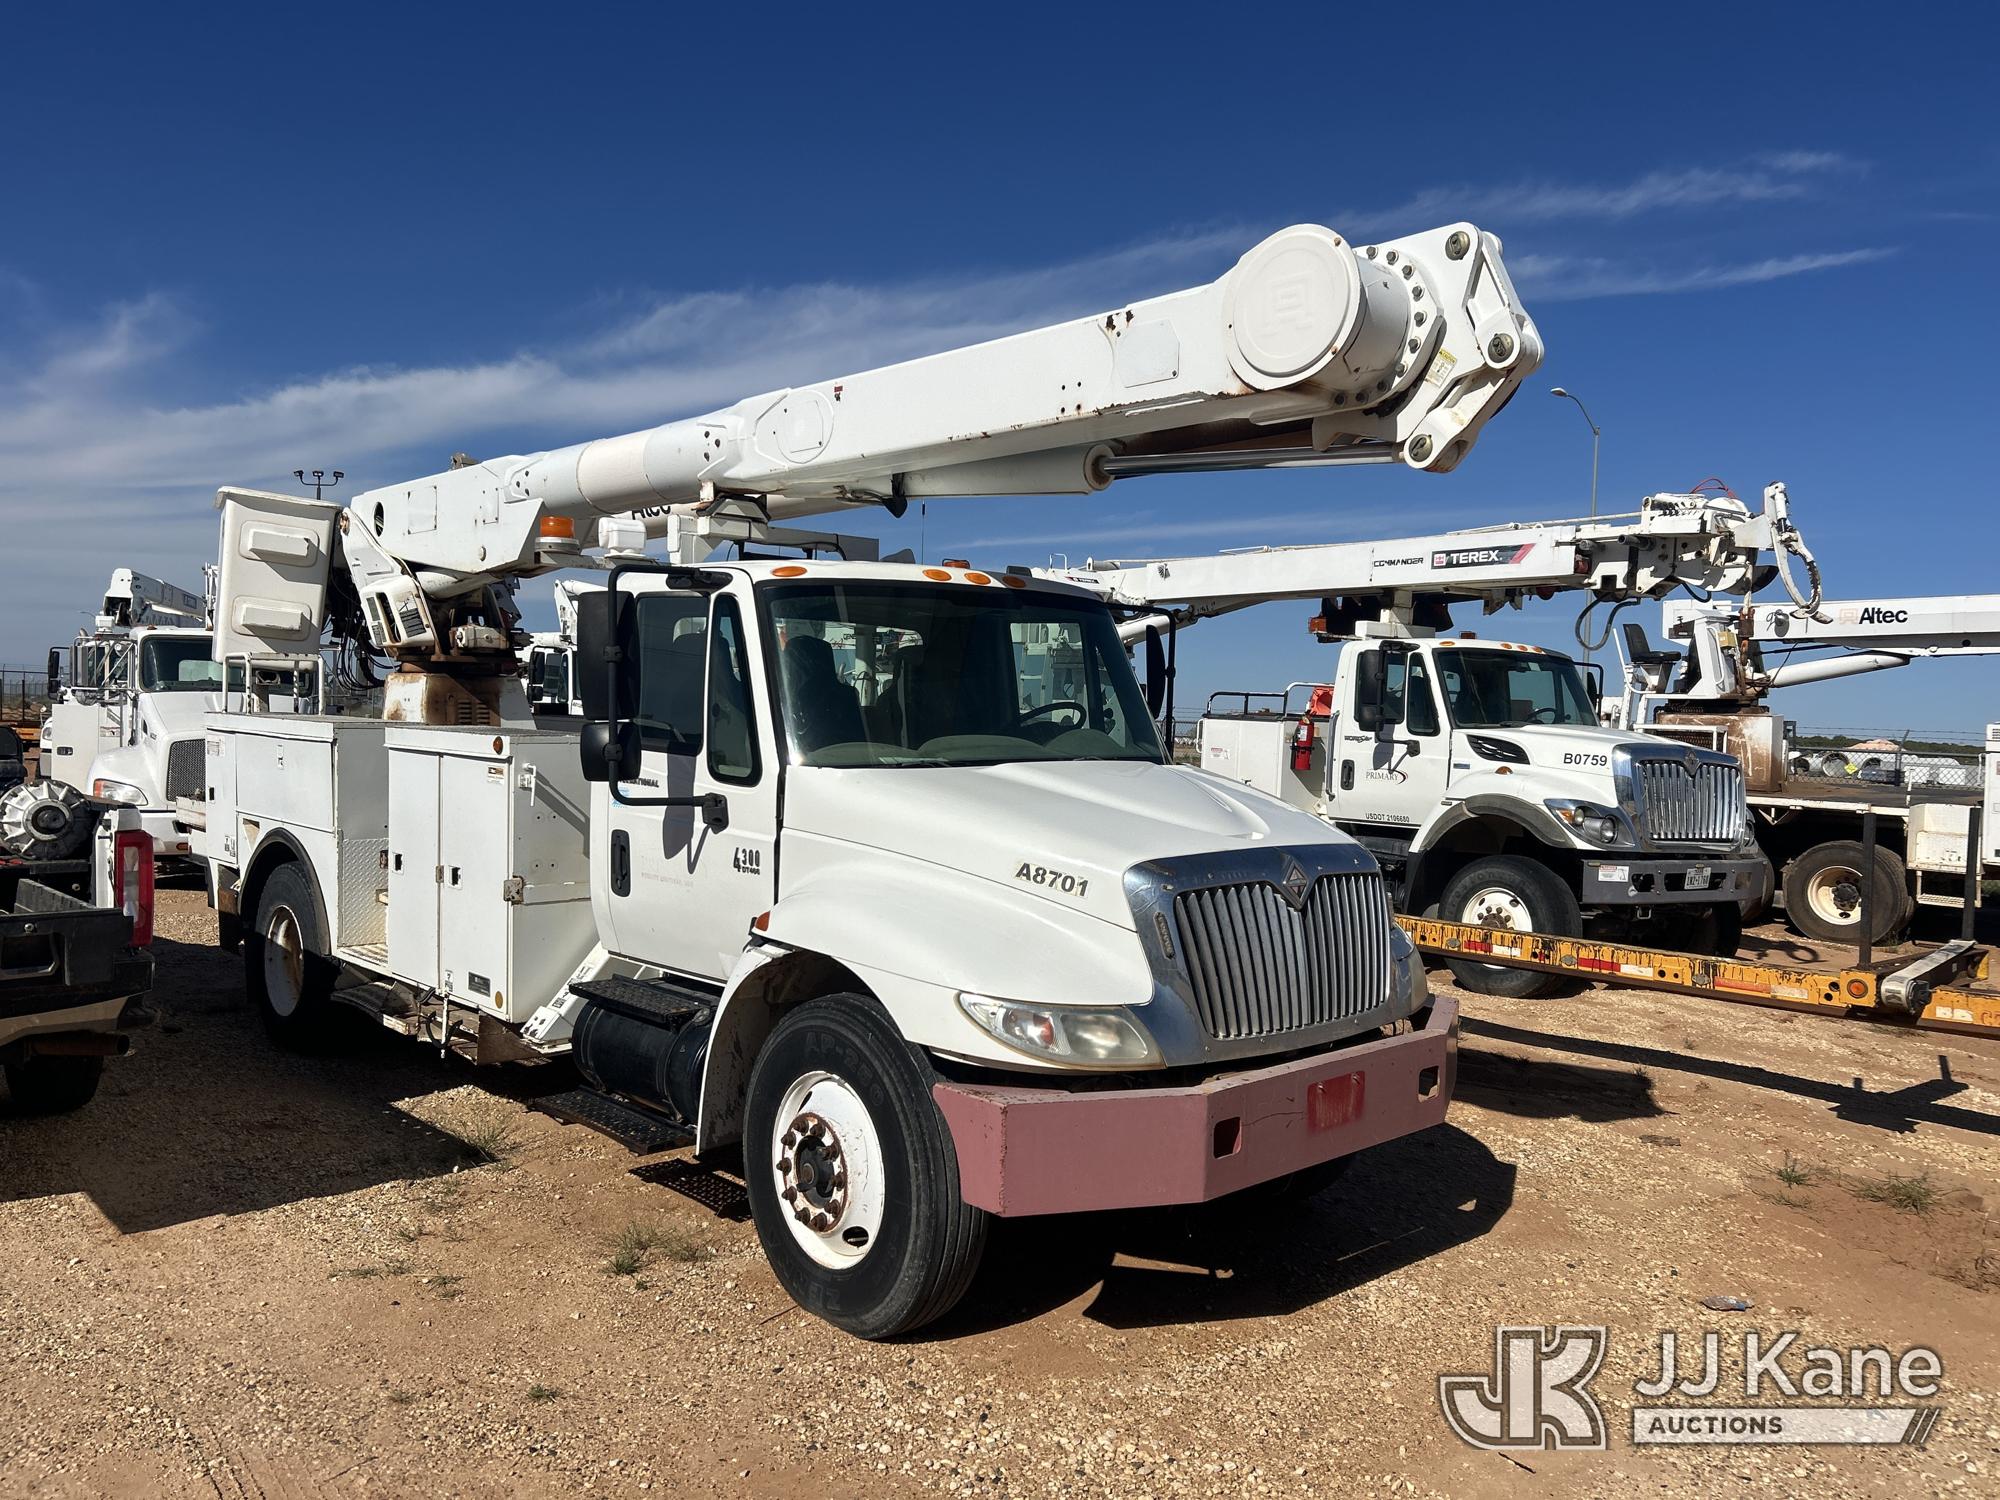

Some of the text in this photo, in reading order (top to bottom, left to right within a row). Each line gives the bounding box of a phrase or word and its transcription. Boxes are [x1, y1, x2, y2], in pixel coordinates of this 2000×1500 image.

[1450, 549, 1499, 565] TEREX
[1858, 607, 1908, 625] Altec
[1563, 752, 1608, 767] B0759
[1366, 771, 1399, 781] PRIMARY
[1365, 812, 1385, 821] USDOT
[733, 847, 760, 873] 4300
[1015, 862, 1089, 897] A8701
